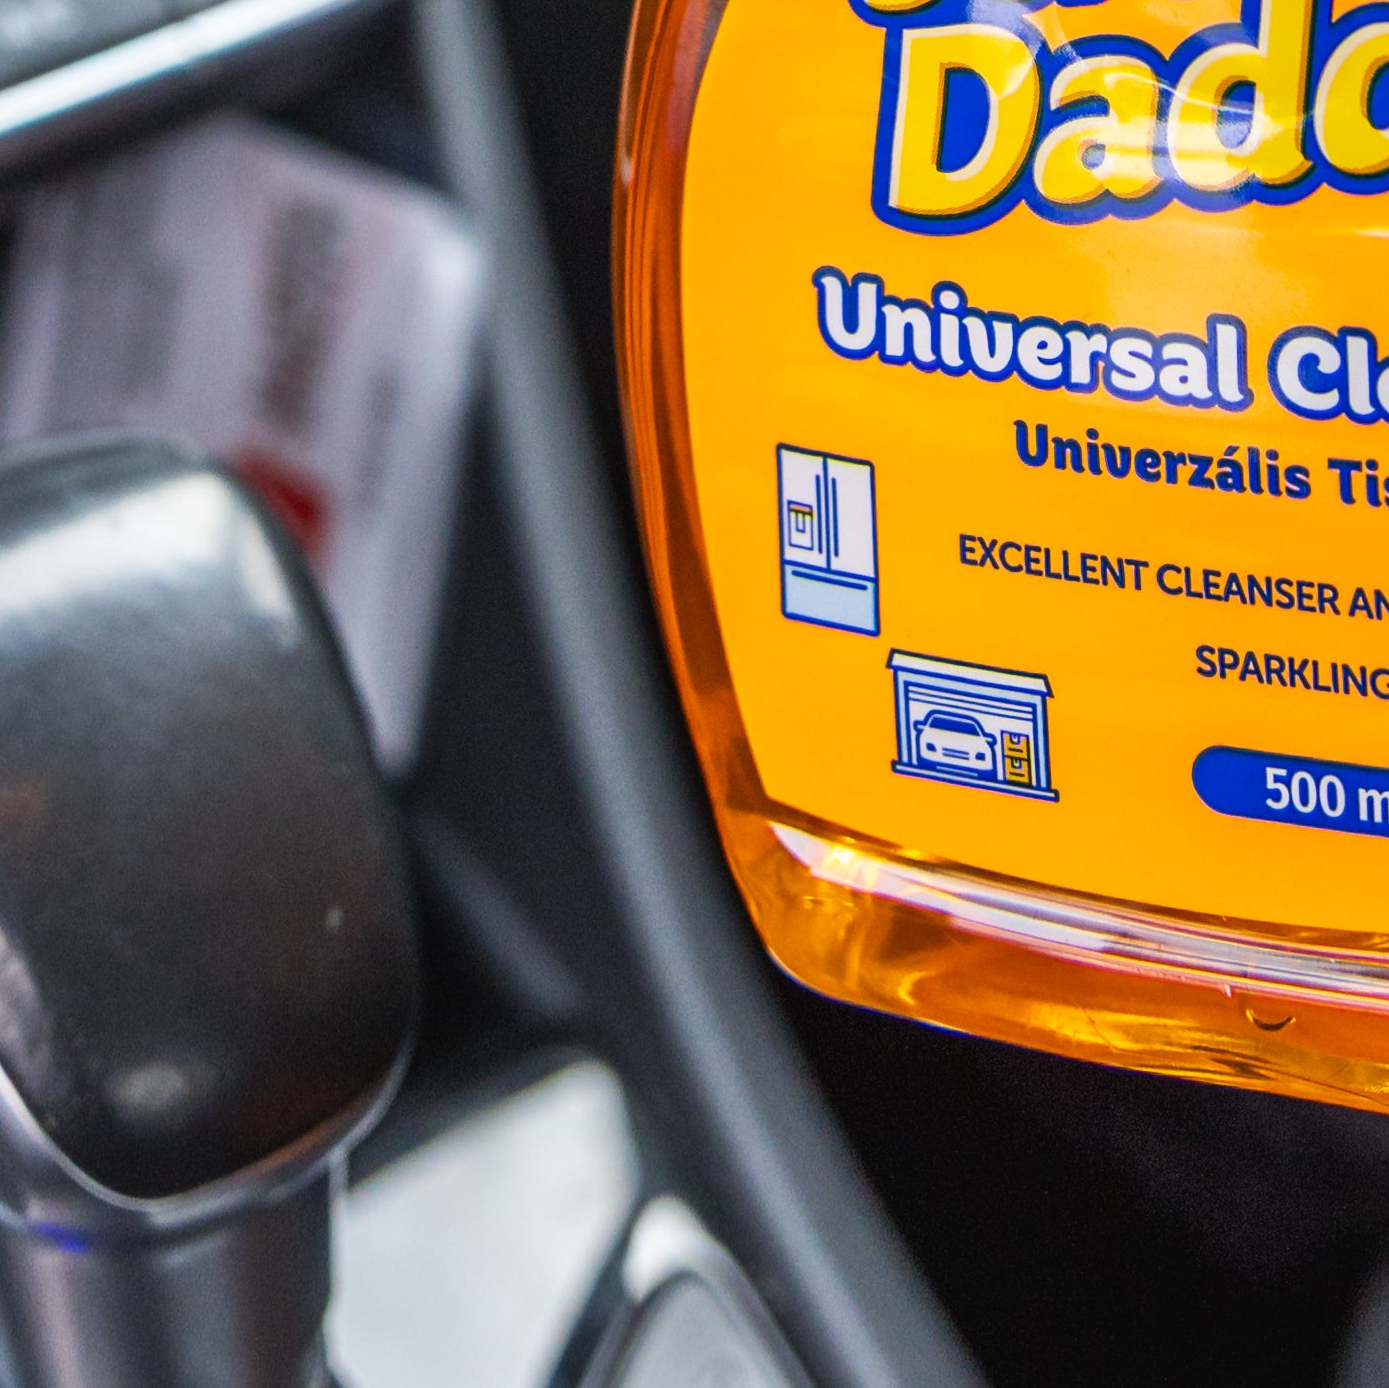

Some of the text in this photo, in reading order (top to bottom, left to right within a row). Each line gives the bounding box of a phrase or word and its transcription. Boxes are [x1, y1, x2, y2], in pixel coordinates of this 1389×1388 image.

[815, 267, 1252, 411] Universal
[1013, 420, 1311, 500] Univerzális
[958, 533, 1150, 594] EXCELLENT
[1156, 562, 1341, 616] CLEANSER
[1264, 767, 1347, 819] 500
